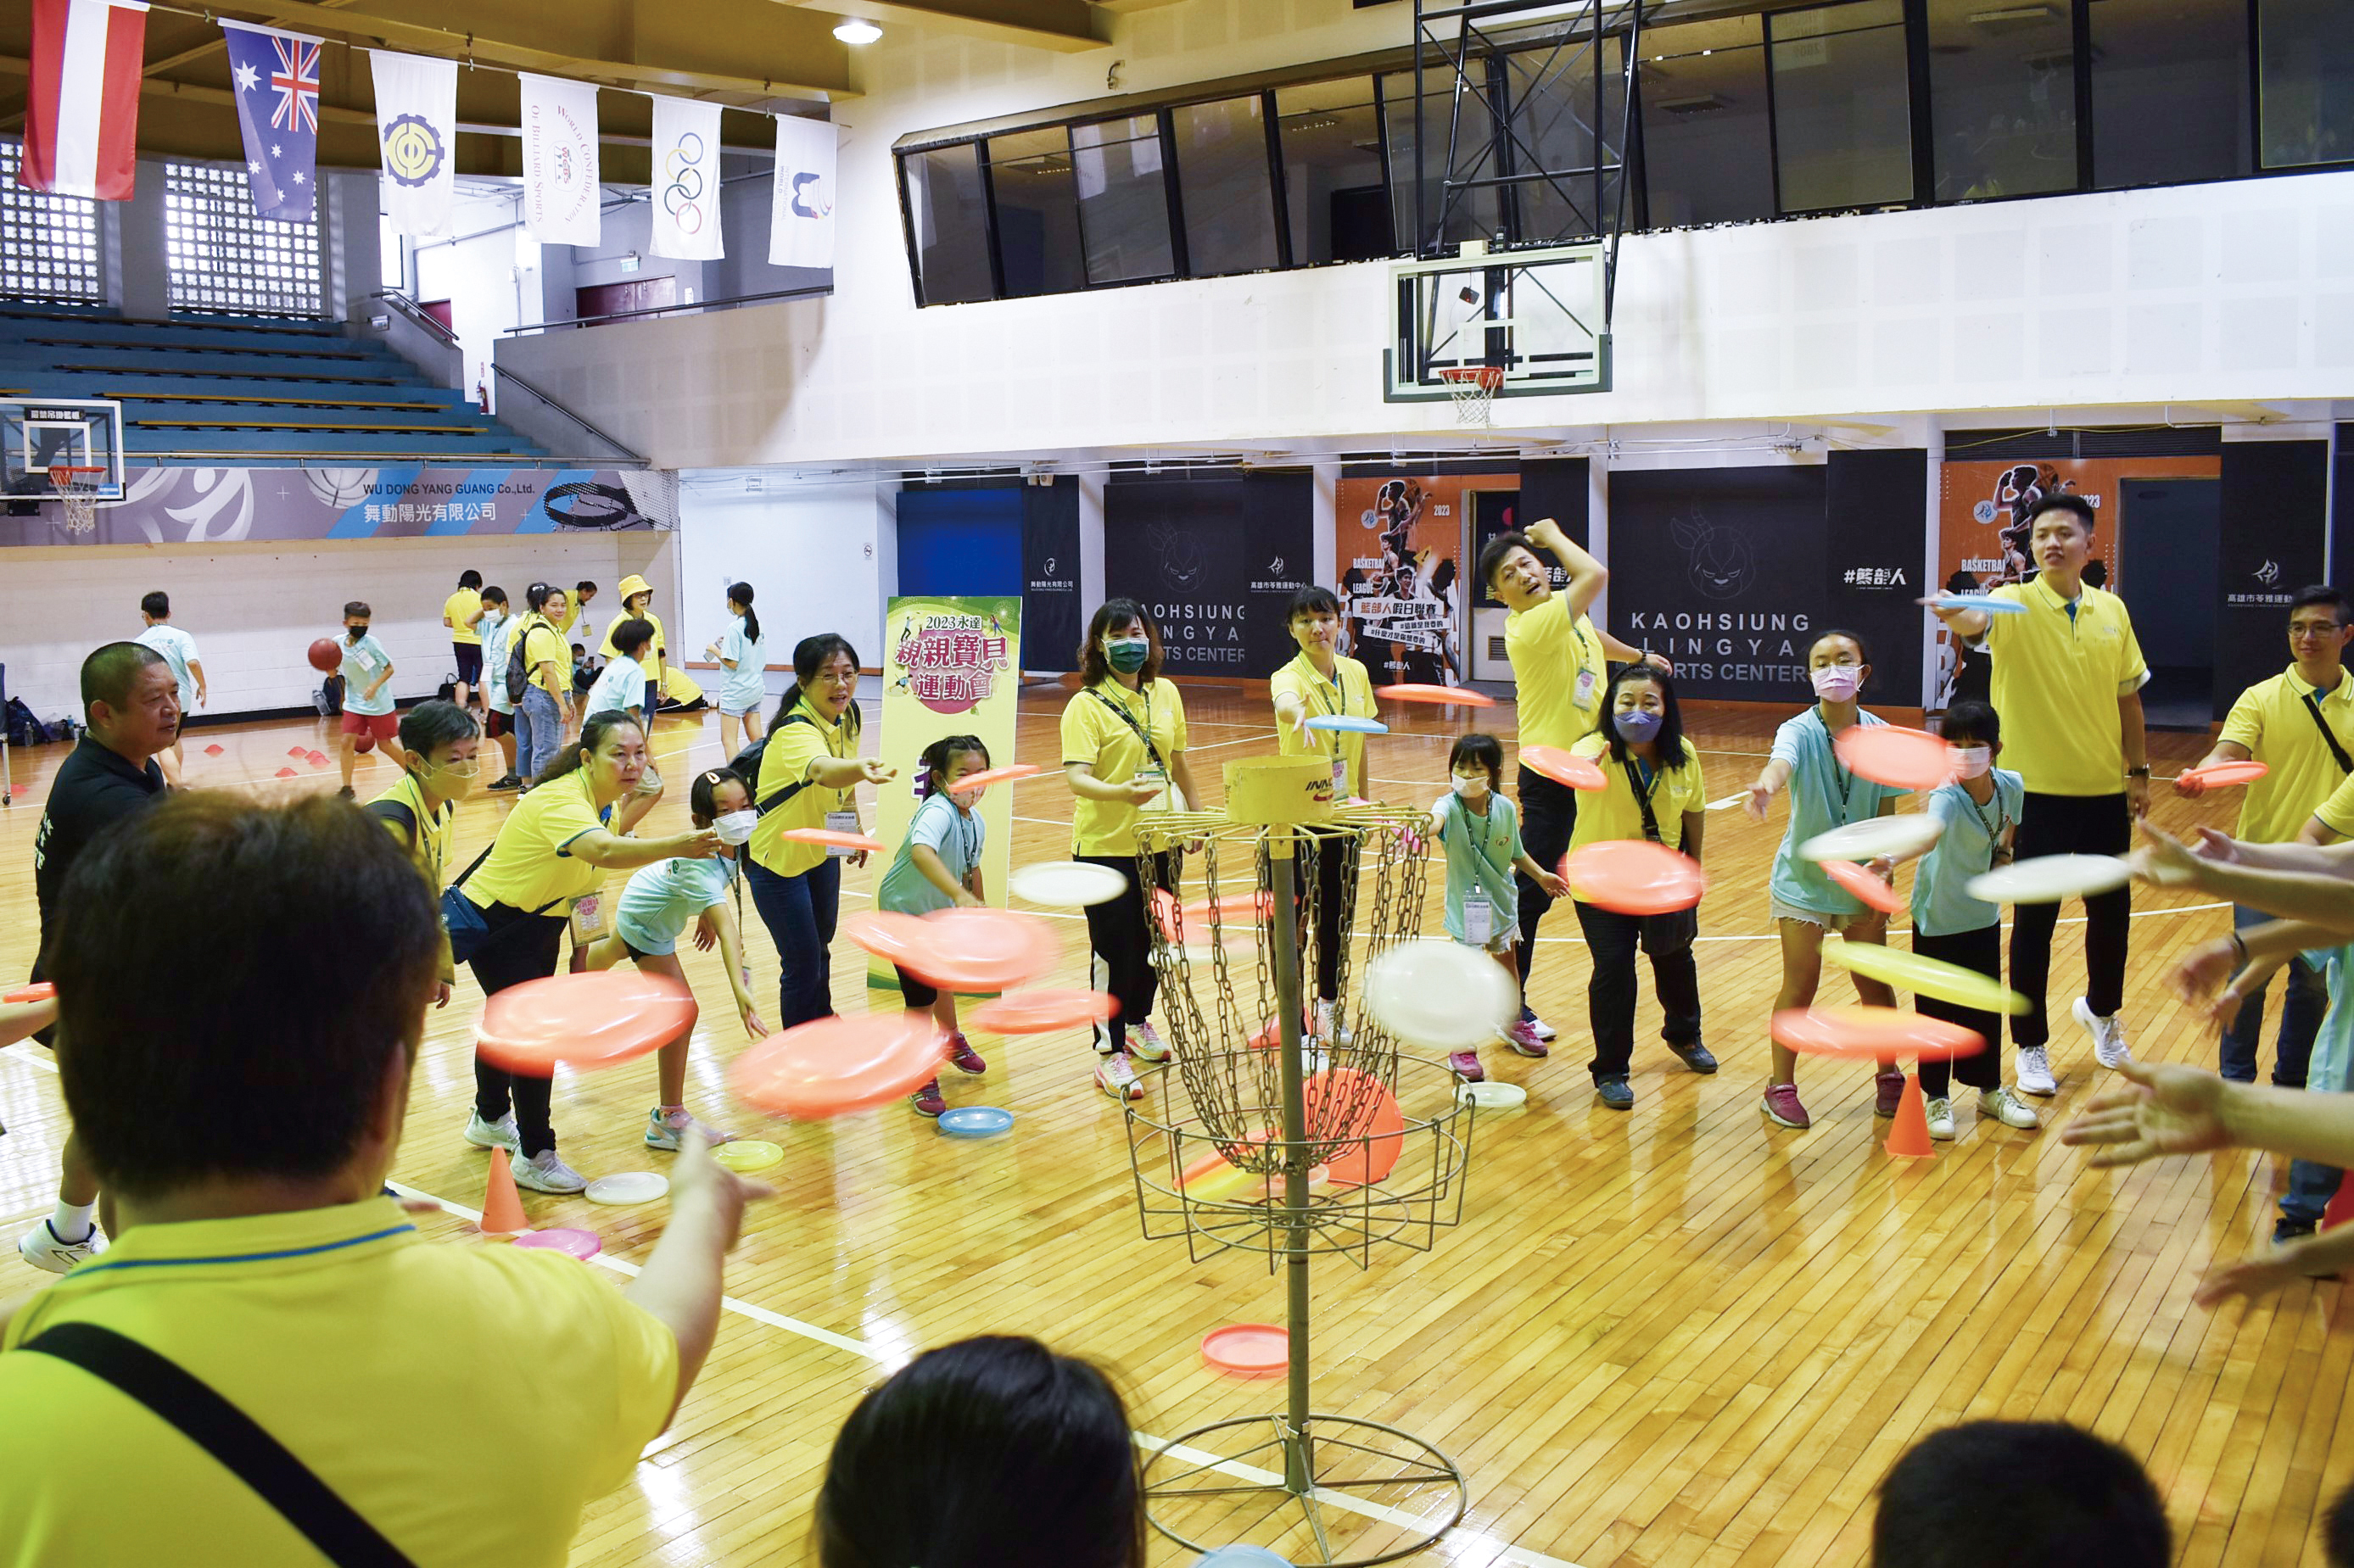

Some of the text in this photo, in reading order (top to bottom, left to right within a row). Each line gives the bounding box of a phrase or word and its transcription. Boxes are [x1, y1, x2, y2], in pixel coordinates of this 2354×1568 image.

[531, 105, 544, 222] OF BILLIARD SPORTS
[558, 105, 593, 224] WORLD CONFEDERATION
[363, 484, 535, 495] WU DONG YANG GUANG Co.,Ltd.
[364, 502, 496, 523] 舞動陽光有限公司
[1434, 505, 1450, 516] 2023
[1353, 583, 1374, 594] LEAGUE
[2228, 594, 2293, 604] 高雄市苓雅運動
[1141, 603, 1245, 620] OHSIUNG
[925, 615, 981, 630] 2023永達
[1631, 612, 1809, 631] KAOHSIUNG
[895, 633, 1009, 670] 親親寶貝
[1720, 664, 1808, 683] CENTER
[917, 671, 993, 700] 運動會
